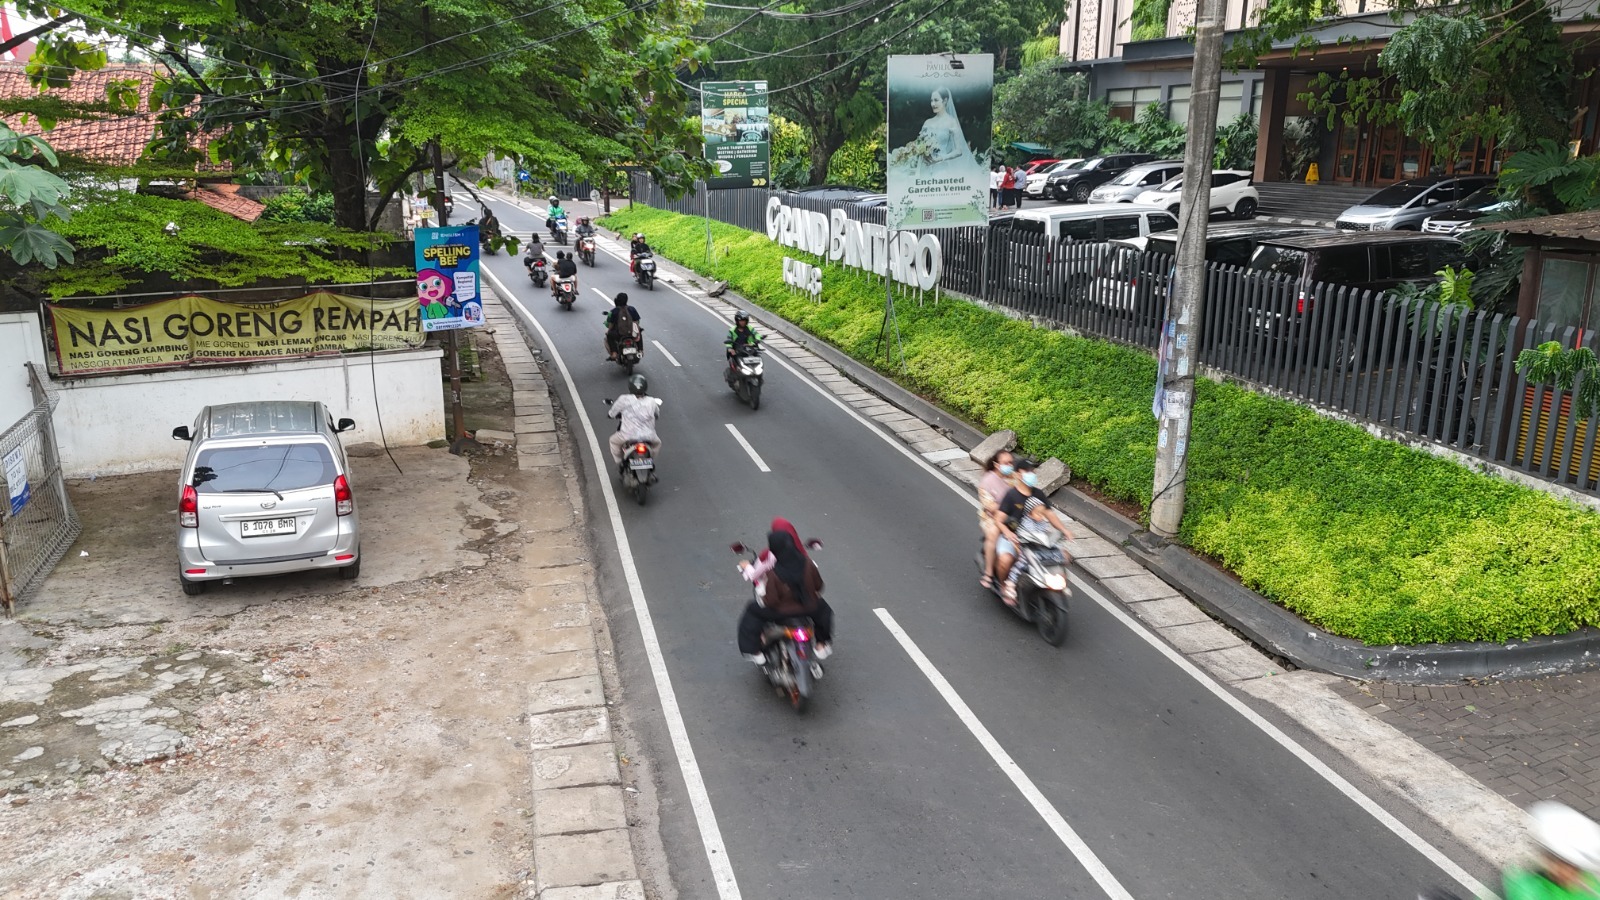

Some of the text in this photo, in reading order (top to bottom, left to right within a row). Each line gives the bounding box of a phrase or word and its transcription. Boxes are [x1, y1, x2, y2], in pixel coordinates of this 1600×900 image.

[722, 98, 749, 106] SPECIAL
[915, 177, 965, 186] Enchanted
[907, 185, 941, 194] Garden
[766, 196, 943, 291] GRAND BINTARO
[423, 246, 471, 258] SPELLING
[439, 256, 458, 266] BEE
[67, 306, 421, 348] NASI GORENG REMPAH
[97, 348, 140, 358] GORENG
[142, 344, 189, 354] KAMBING
[195, 340, 211, 348] MIE
[212, 340, 250, 348] GORENG
[257, 338, 279, 348] NASI
[281, 337, 313, 346] LEMAK
[112, 358, 125, 367] ATI
[127, 355, 163, 365] AMPELA
[173, 351, 194, 361] AYA
[195, 349, 236, 357] GORENG
[238, 348, 284, 357] KARAAGE
[315, 343, 347, 351] SAMBAL
[243, 519, 294, 531] B 1078 BMR
